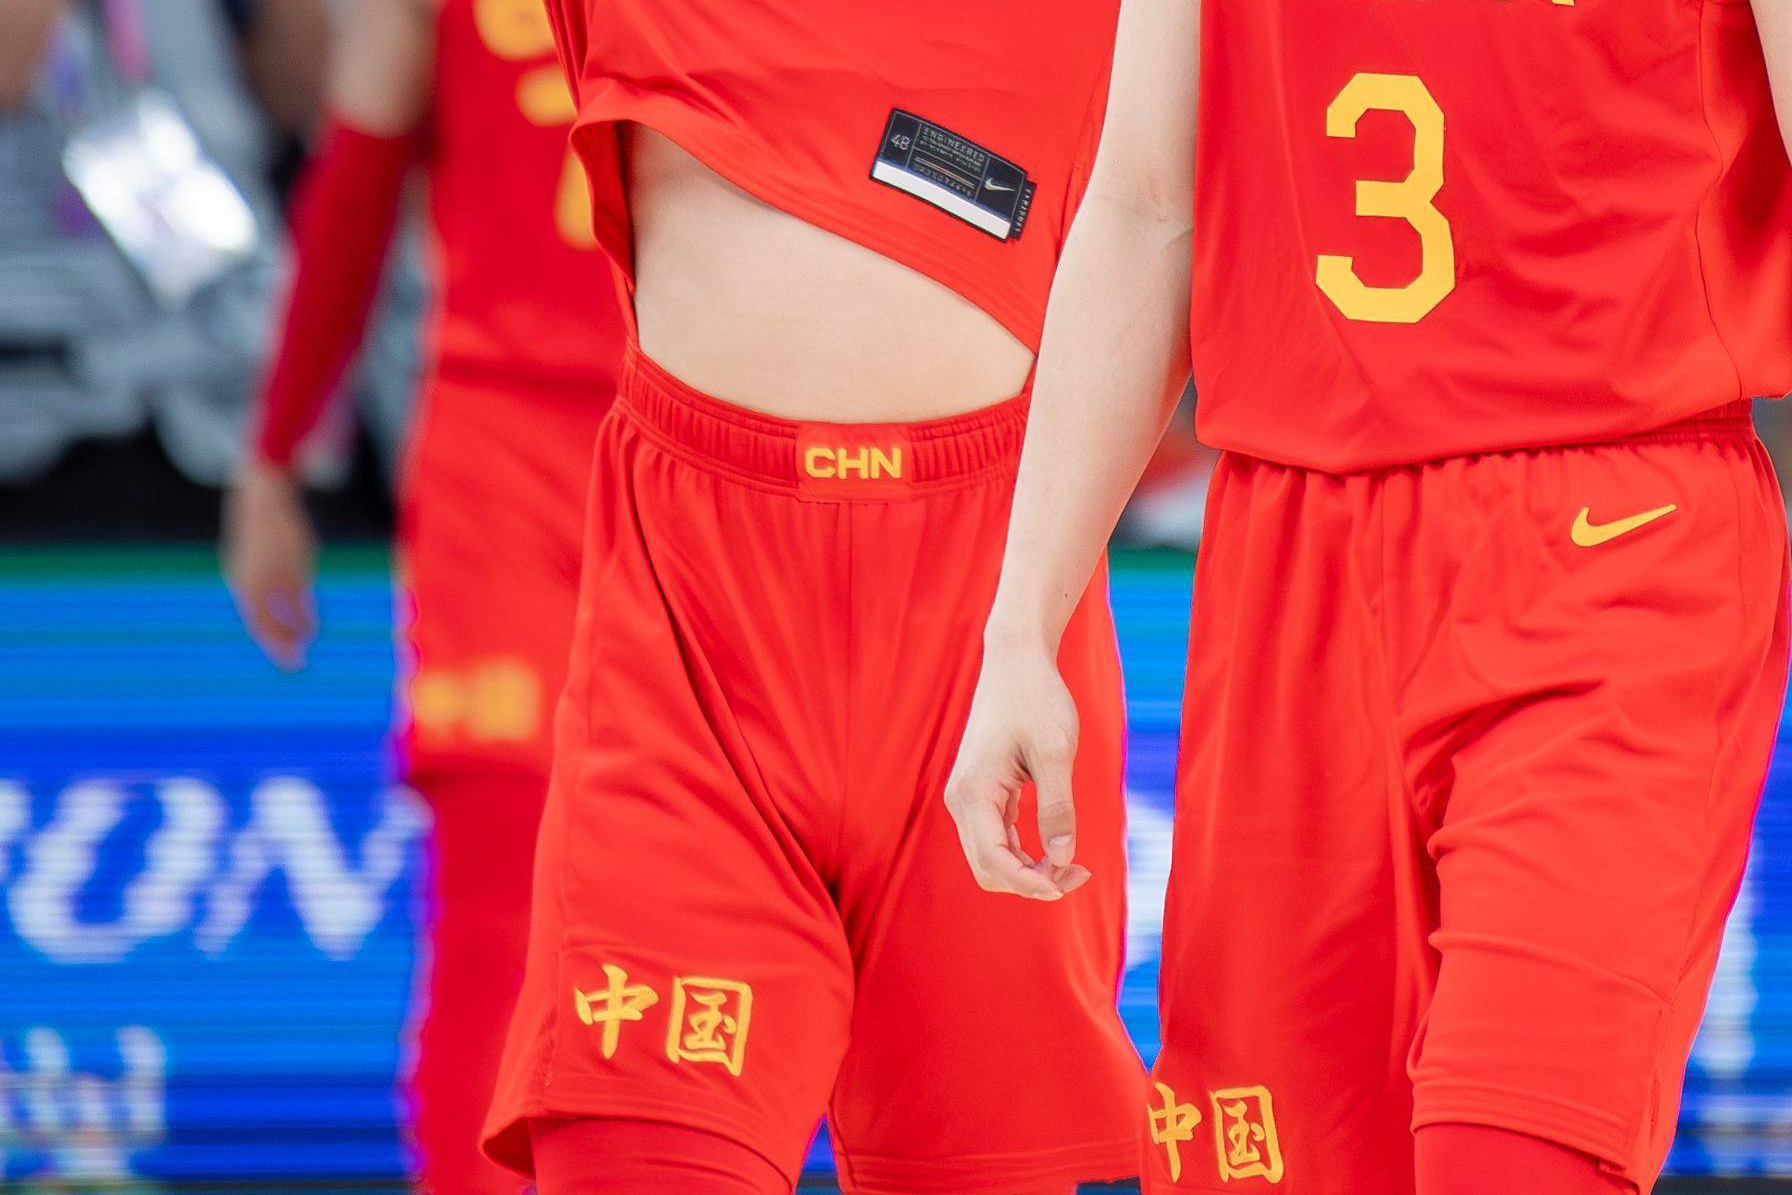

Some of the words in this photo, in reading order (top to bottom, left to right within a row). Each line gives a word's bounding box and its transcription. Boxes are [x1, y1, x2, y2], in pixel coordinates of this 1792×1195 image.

[891, 133, 911, 151] 48
[1314, 71, 1456, 324] 3
[804, 446, 902, 480] CHN
[574, 964, 754, 1077] 中国
[1147, 1081, 1285, 1183] 中国
